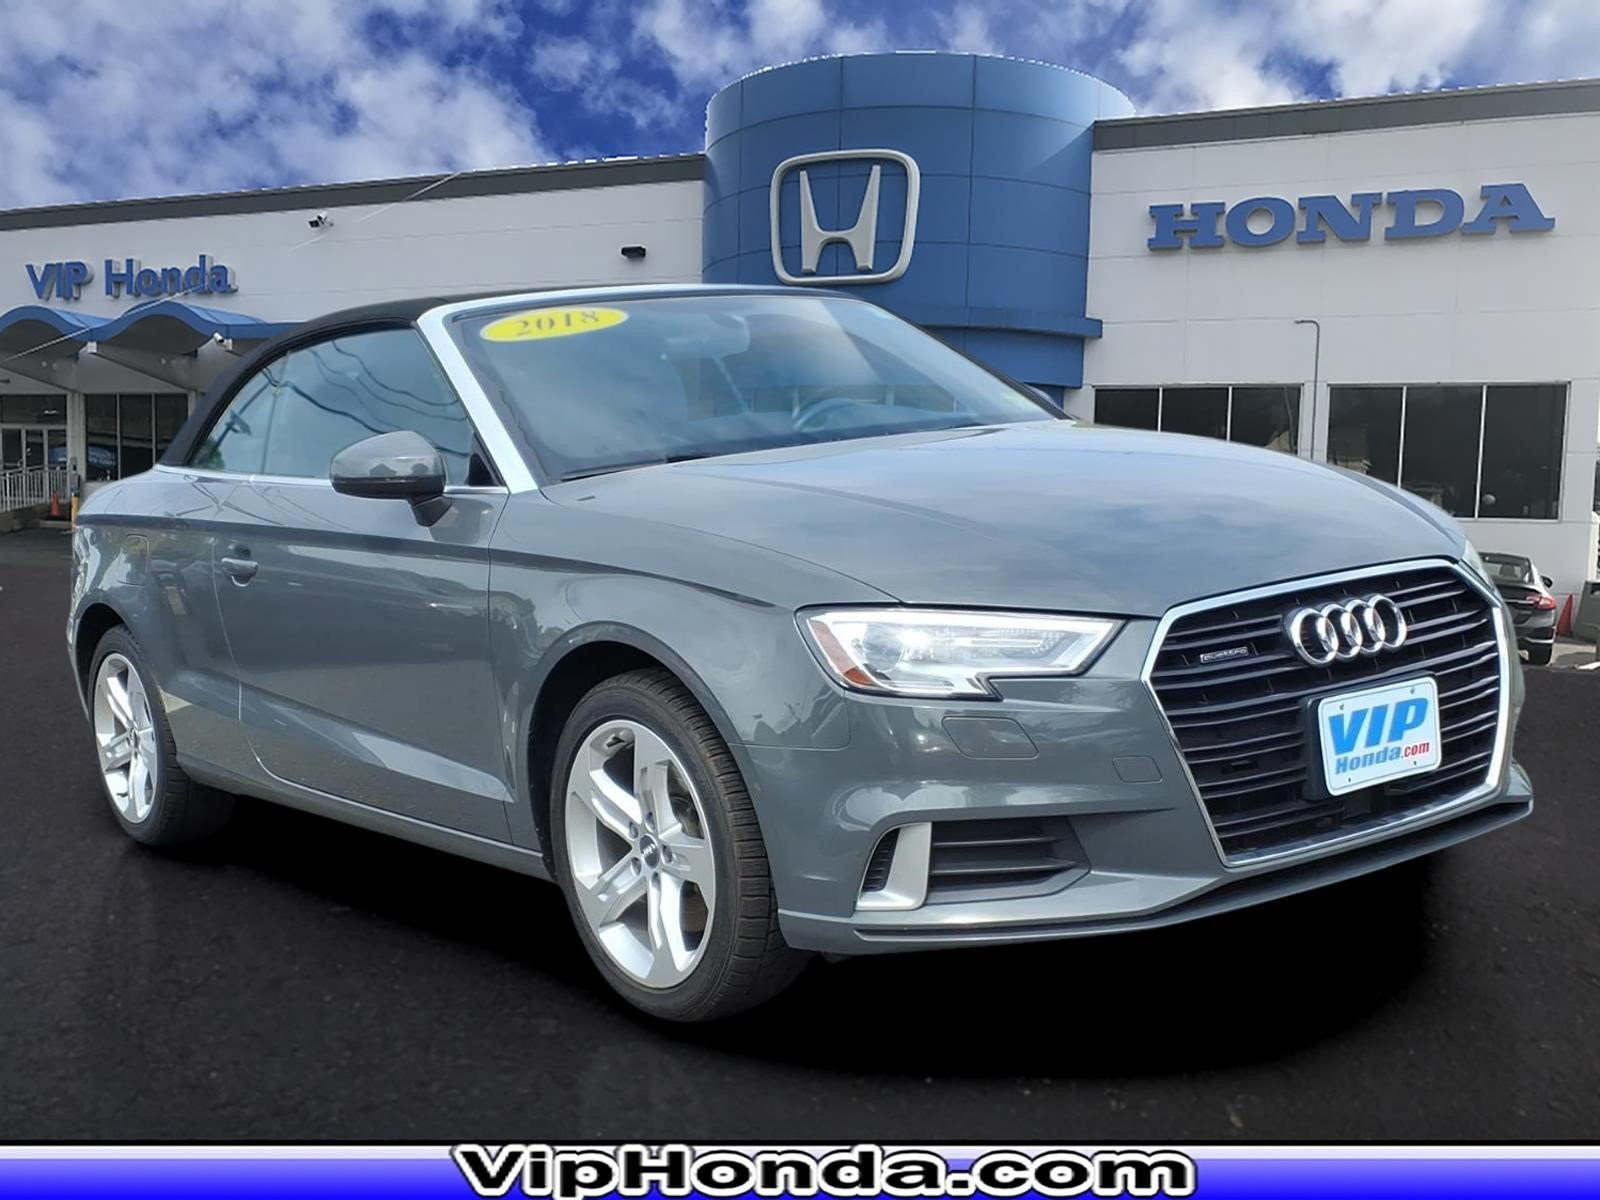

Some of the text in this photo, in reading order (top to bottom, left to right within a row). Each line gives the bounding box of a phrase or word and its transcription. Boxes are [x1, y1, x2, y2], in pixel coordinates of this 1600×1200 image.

[1147, 182, 1556, 250] HONDA
[25, 254, 237, 300] VIP Honda
[516, 311, 599, 336] 2018
[1328, 698, 1429, 756] VIP
[1335, 742, 1430, 775] Honda.com
